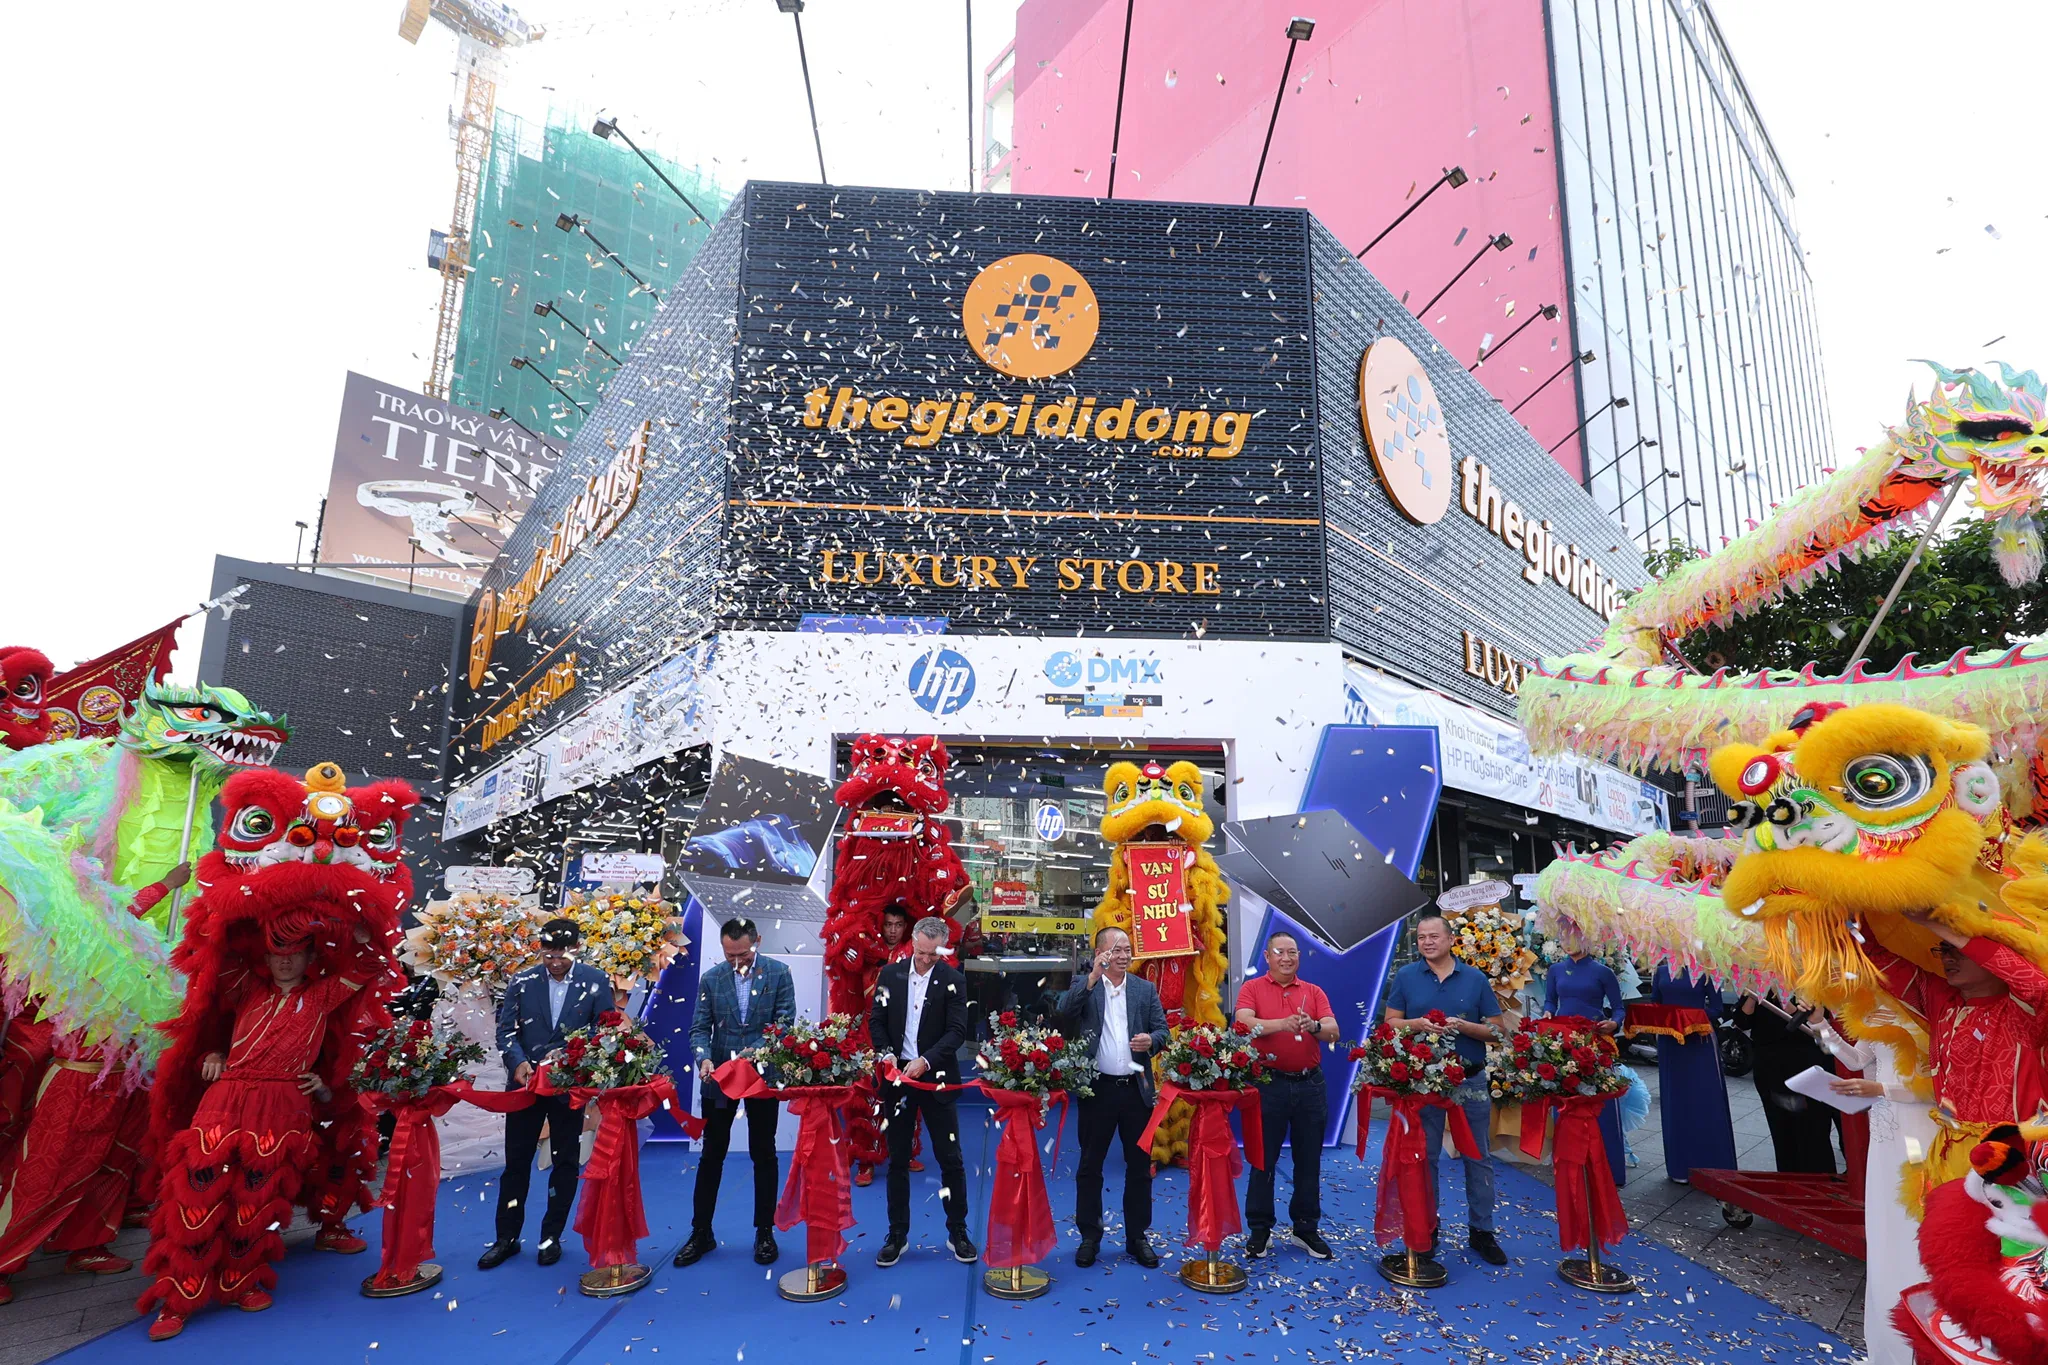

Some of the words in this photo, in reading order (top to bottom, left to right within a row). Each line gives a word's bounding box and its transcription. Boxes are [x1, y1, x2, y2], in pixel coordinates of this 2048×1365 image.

[375, 390, 444, 426] TRAO
[450, 416, 484, 437] KỶ
[803, 386, 1252, 459] thegioididong
[1152, 444, 1204, 457] .com
[818, 550, 1038, 589] LUXURY
[1057, 557, 1221, 595] STORE
[918, 649, 973, 716] hp
[1087, 658, 1162, 683] DMX
[1444, 717, 1466, 744] Khai
[1446, 745, 1462, 768] HP
[1464, 753, 1503, 786] Flagship
[1503, 765, 1529, 789] Store
[1559, 768, 1576, 789] Bird
[1539, 781, 1553, 808] 20
[1039, 806, 1062, 841] hp
[1140, 862, 1173, 878] VẠN
[1147, 879, 1169, 902] SỰ
[1142, 899, 1178, 920] NHƯ
[991, 920, 1016, 929] OPEN
[1055, 922, 1075, 931] 8:00
[1156, 922, 1168, 942] Ý
